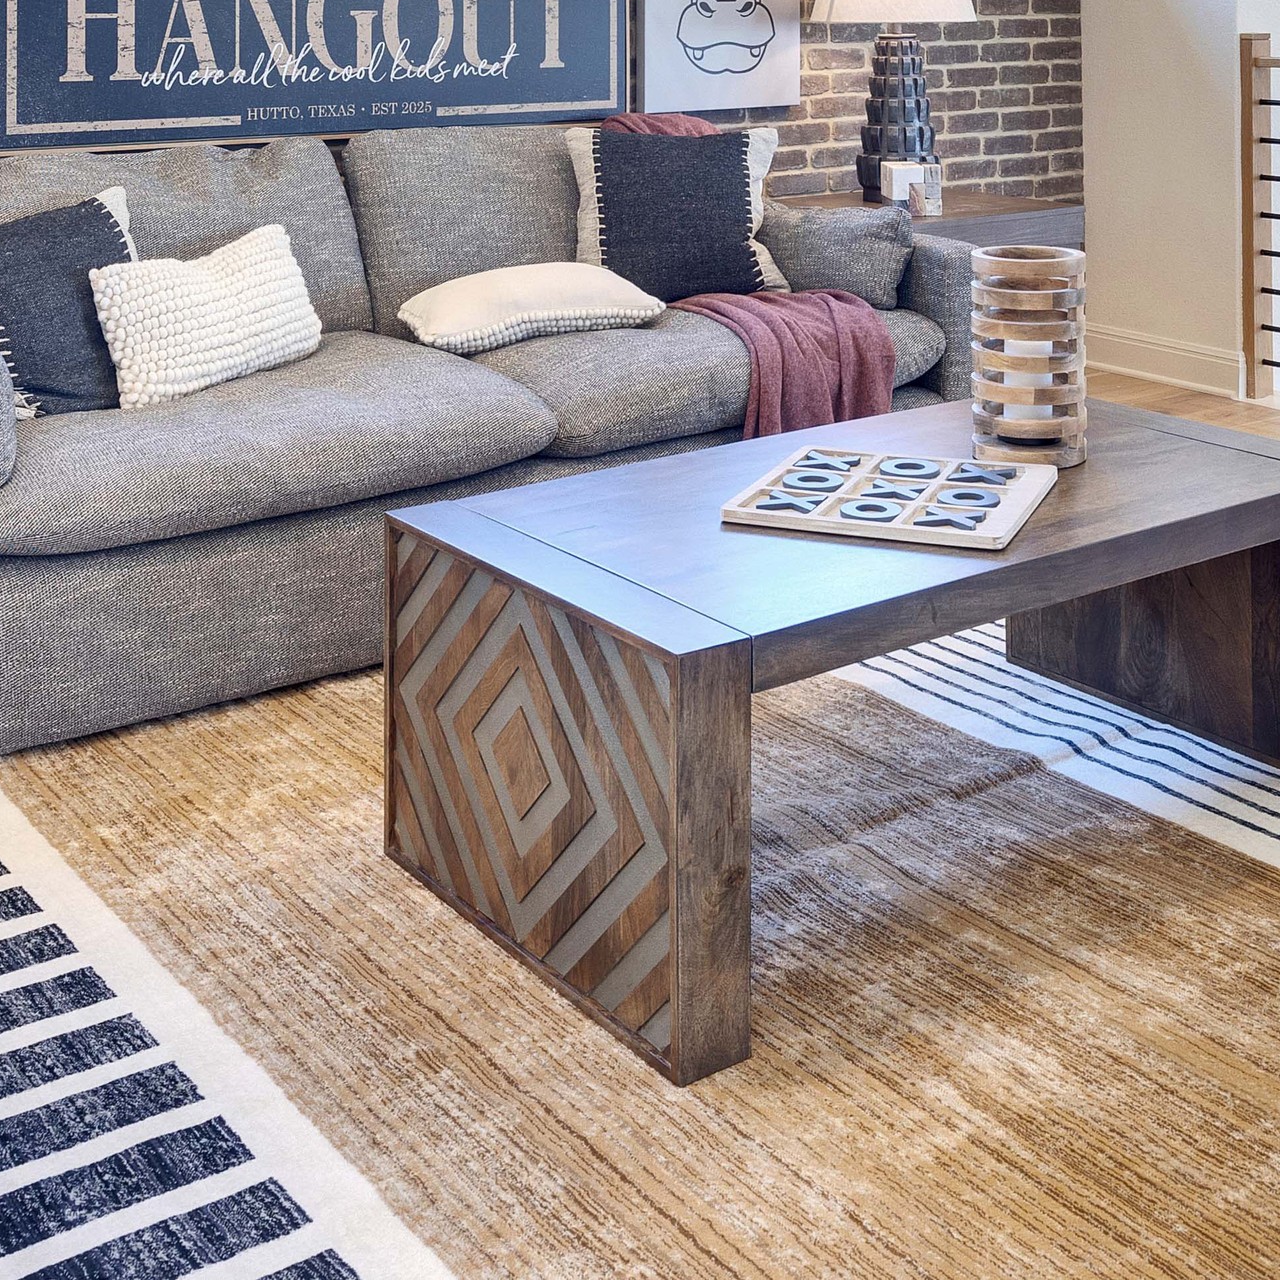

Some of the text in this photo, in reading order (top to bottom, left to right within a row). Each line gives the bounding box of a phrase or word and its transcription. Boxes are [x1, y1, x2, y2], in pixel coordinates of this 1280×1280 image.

[141, 36, 520, 91] where all the cool kids meet
[246, 101, 433, 121] HUTTO, TEXAS EST 2025
